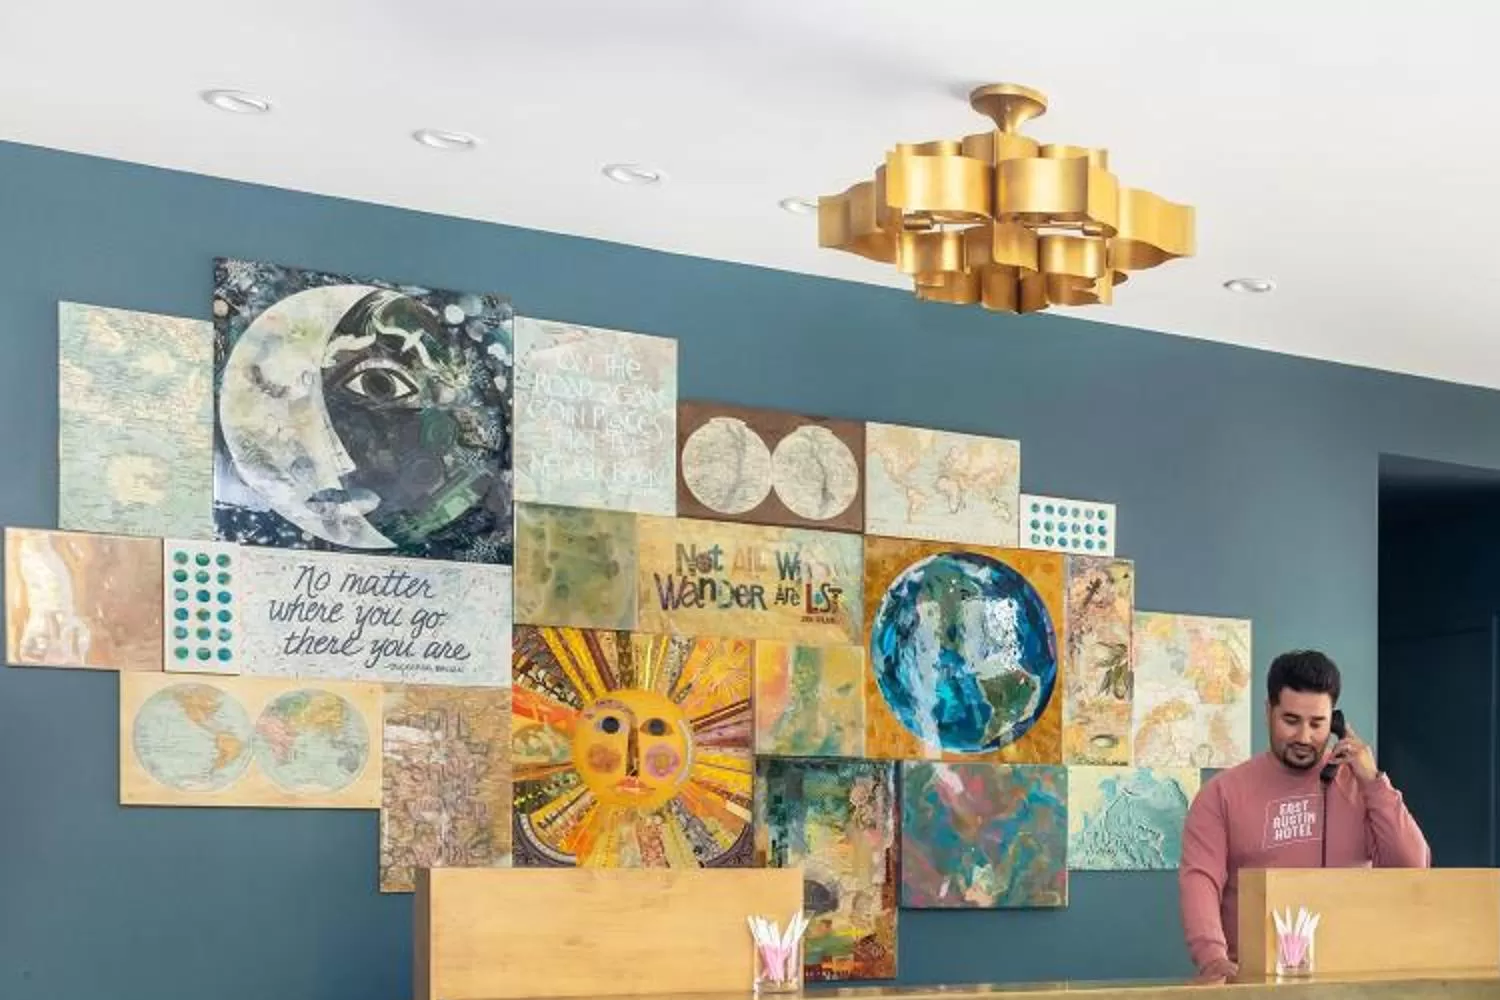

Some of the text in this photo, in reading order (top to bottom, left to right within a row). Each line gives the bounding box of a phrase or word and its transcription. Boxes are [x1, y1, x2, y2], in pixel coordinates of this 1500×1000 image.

[675, 543, 723, 577] Not
[293, 565, 437, 600] No matter
[268, 593, 346, 624] where
[350, 601, 403, 641] you
[284, 626, 471, 669] there you are
[1273, 812, 1316, 829] AUSTIN
[1275, 824, 1313, 841] HOTEL
